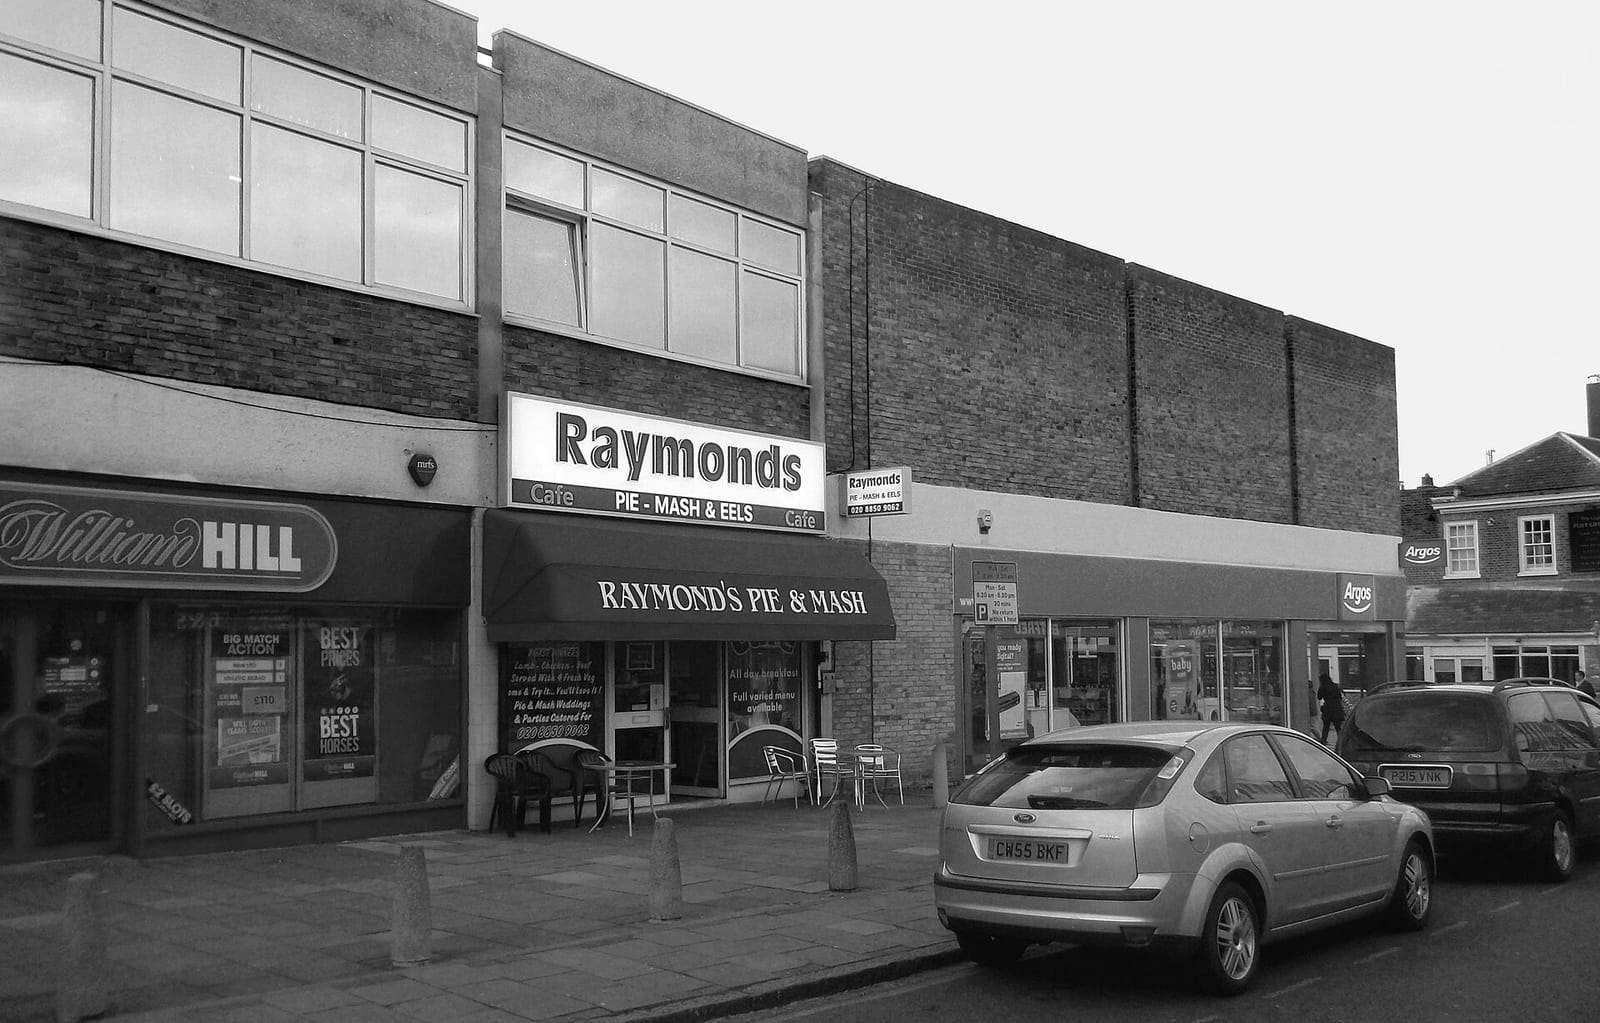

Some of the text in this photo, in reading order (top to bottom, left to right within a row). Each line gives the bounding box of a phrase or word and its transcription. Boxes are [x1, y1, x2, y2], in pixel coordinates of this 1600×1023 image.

[556, 411, 802, 492] Raymonds
[849, 473, 901, 490] Raymonds
[530, 483, 574, 507] Cafe
[863, 492, 880, 501] MASH
[887, 491, 901, 499] EELS
[615, 490, 640, 512] PIE
[655, 494, 700, 518] MASH
[705, 500, 716, 519] &
[720, 502, 754, 523] EELS
[850, 506, 864, 514] 020
[785, 510, 816, 529] Cafe
[0, 500, 302, 572] William HILL
[1404, 546, 1441, 559] Argos
[598, 580, 868, 614] RAYMOND'S PIE & MASH
[1344, 582, 1372, 605] Argos
[979, 605, 987, 619] P
[223, 634, 280, 644] BIG MATCH
[320, 627, 359, 649] BEST
[227, 643, 275, 655] ACTION
[320, 650, 360, 667] PRICES
[514, 660, 536, 670] Lamb
[1171, 657, 1191, 672] baby
[511, 674, 537, 682] Served
[537, 673, 555, 682] With
[563, 673, 582, 682] Fresh
[583, 673, 596, 684] Veg
[729, 668, 798, 680] All day breakfast
[531, 687, 544, 698] Try
[576, 687, 591, 695] Love
[733, 690, 795, 702] Full varied menu
[254, 695, 274, 705] £110
[513, 699, 591, 710] Pie & Mash Weddings
[746, 702, 783, 713] available
[514, 711, 592, 724] & Parties Catered For
[320, 714, 359, 738] BEST
[516, 724, 590, 740] 020 8850 9062
[320, 737, 360, 753] HORSES
[1391, 771, 1442, 782] P215 VNK
[148, 783, 165, 799] £2
[161, 794, 191, 823] SLOTS
[996, 842, 1065, 860] CW55 BKF
